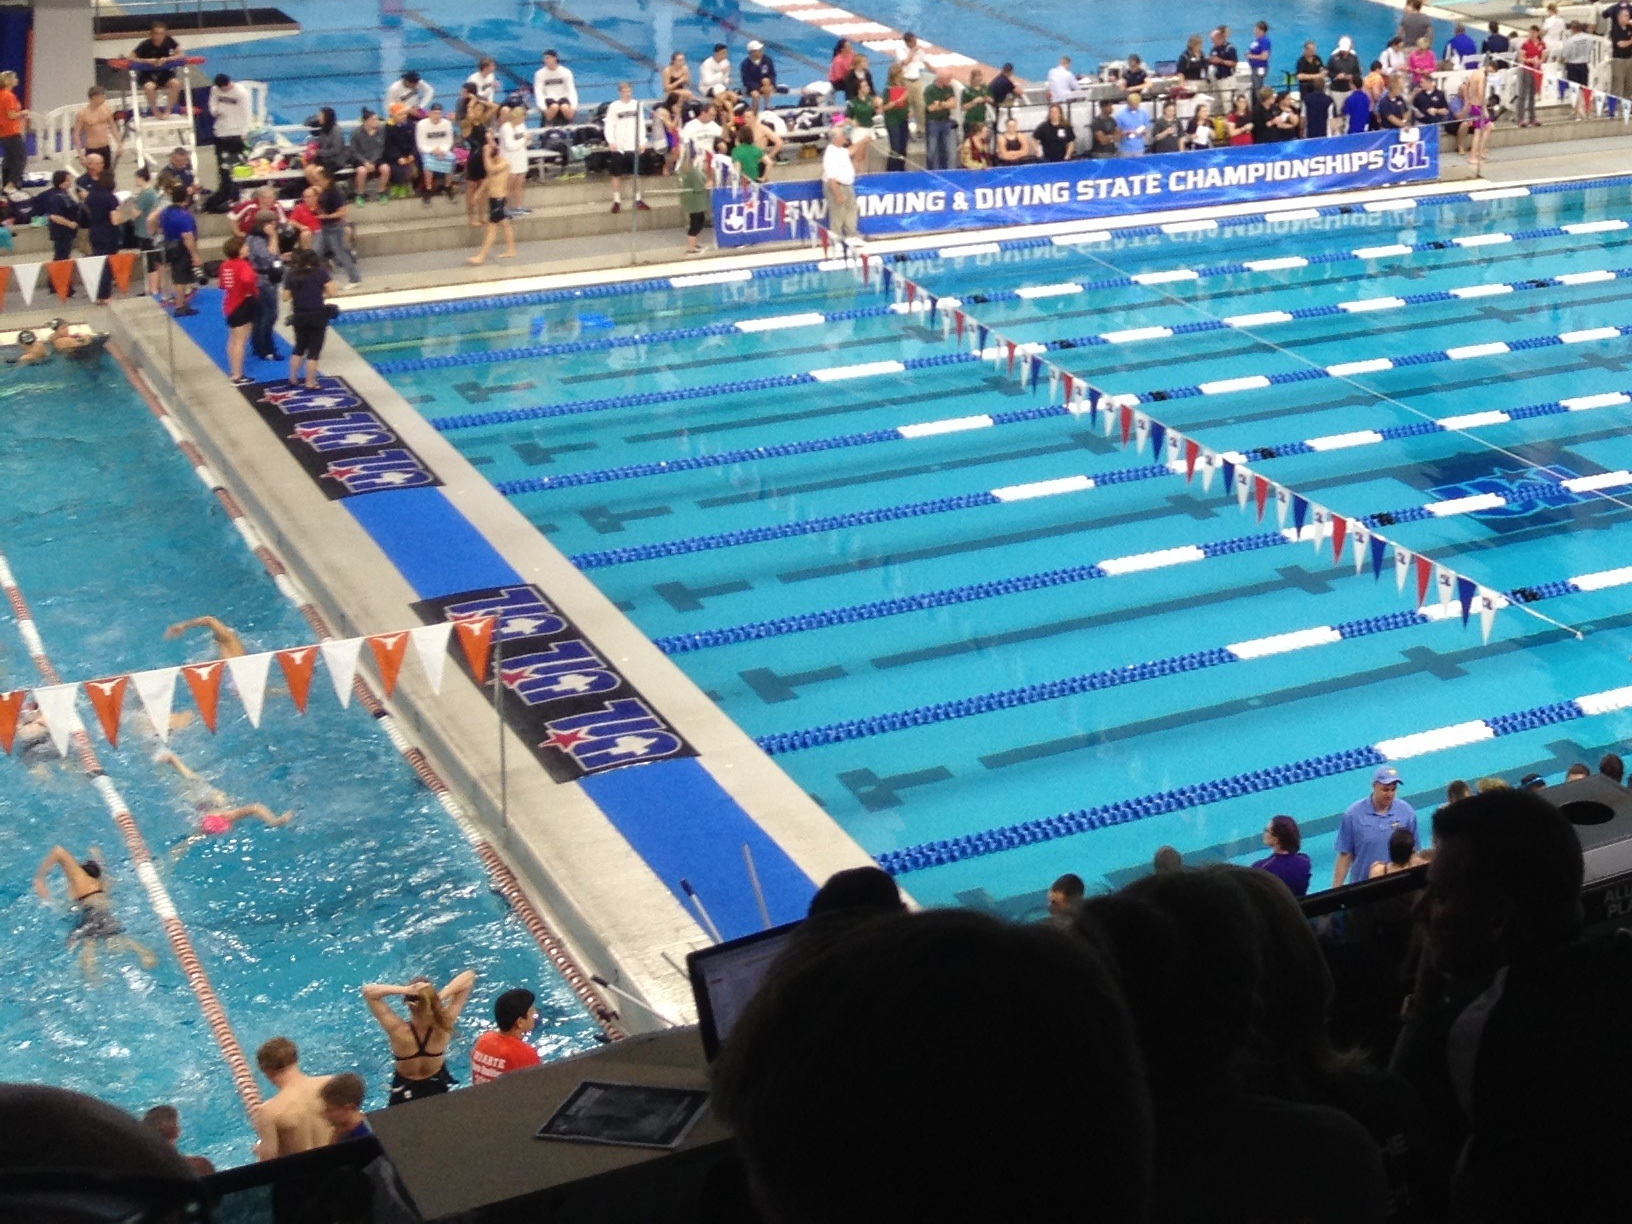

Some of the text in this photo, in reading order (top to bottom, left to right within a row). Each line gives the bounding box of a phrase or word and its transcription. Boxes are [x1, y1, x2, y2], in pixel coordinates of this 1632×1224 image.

[784, 149, 1384, 223] SWMING & DIVING STATE CHAMPIONSHIPS
